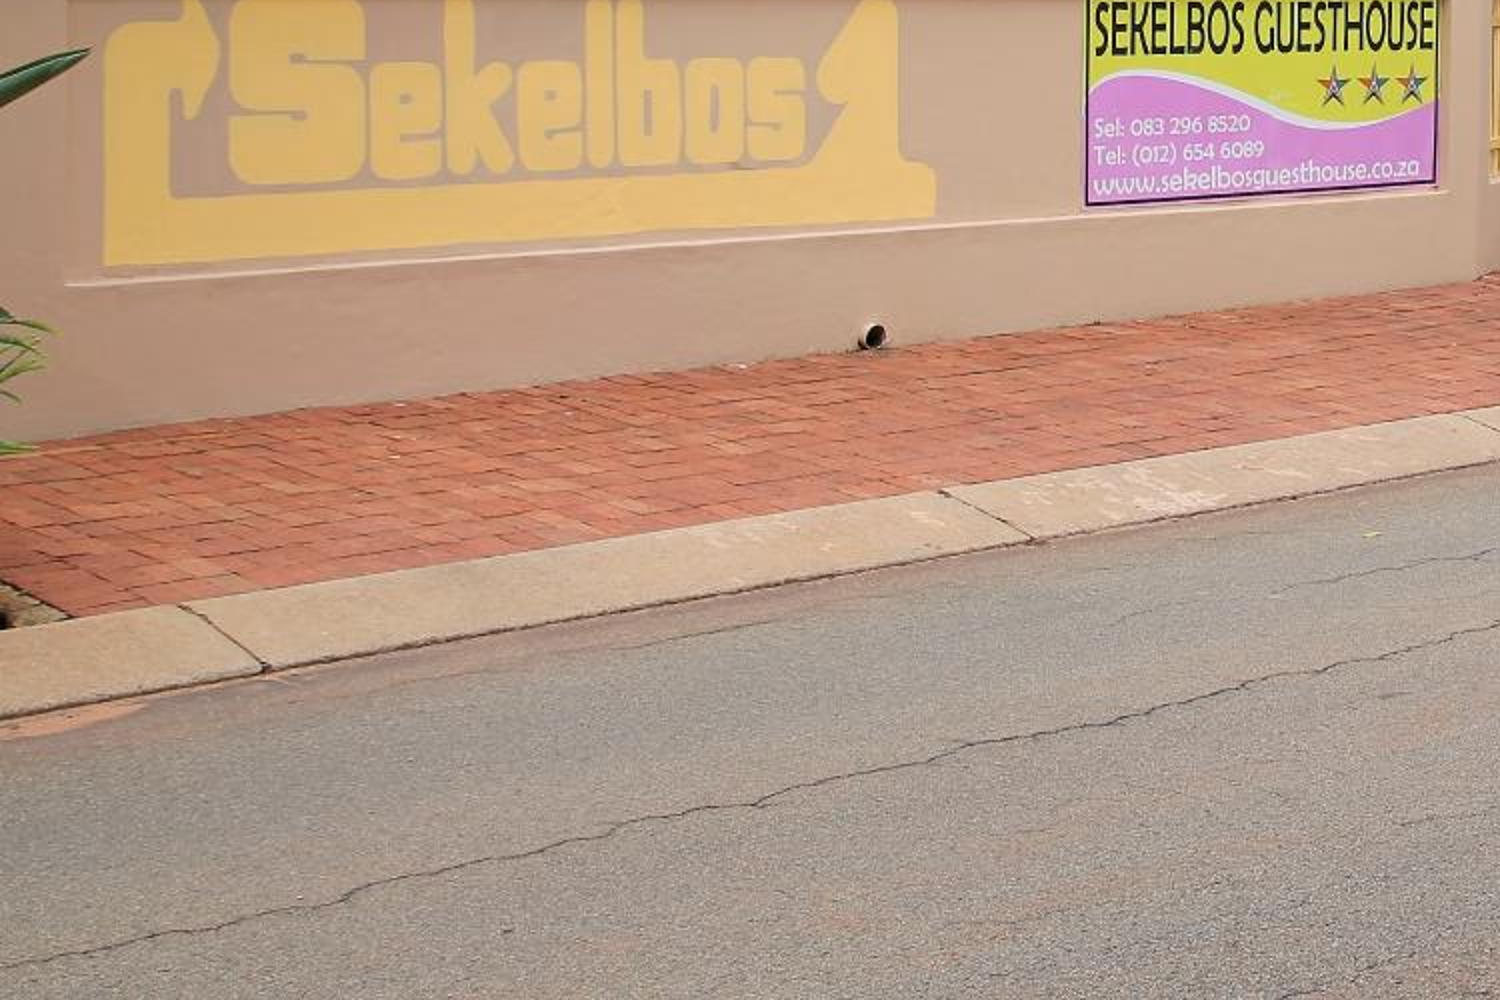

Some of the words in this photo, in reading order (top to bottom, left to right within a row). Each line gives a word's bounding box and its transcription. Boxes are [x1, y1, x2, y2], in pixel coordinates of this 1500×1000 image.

[1095, 0, 1245, 57] SEKELBOS
[1254, 0, 1434, 55] GUESTHOUSE
[1094, 117, 1125, 138] Sel:
[1130, 118, 1164, 137] 083
[1169, 117, 1203, 135] 296
[1208, 115, 1251, 133] 8520
[1094, 145, 1126, 166] Tel:
[1132, 143, 1177, 167] (012)
[1183, 143, 1215, 161] 654
[1220, 141, 1265, 159] 6089
[1093, 159, 1420, 195] www.sekelbosguesthouse.co.za
